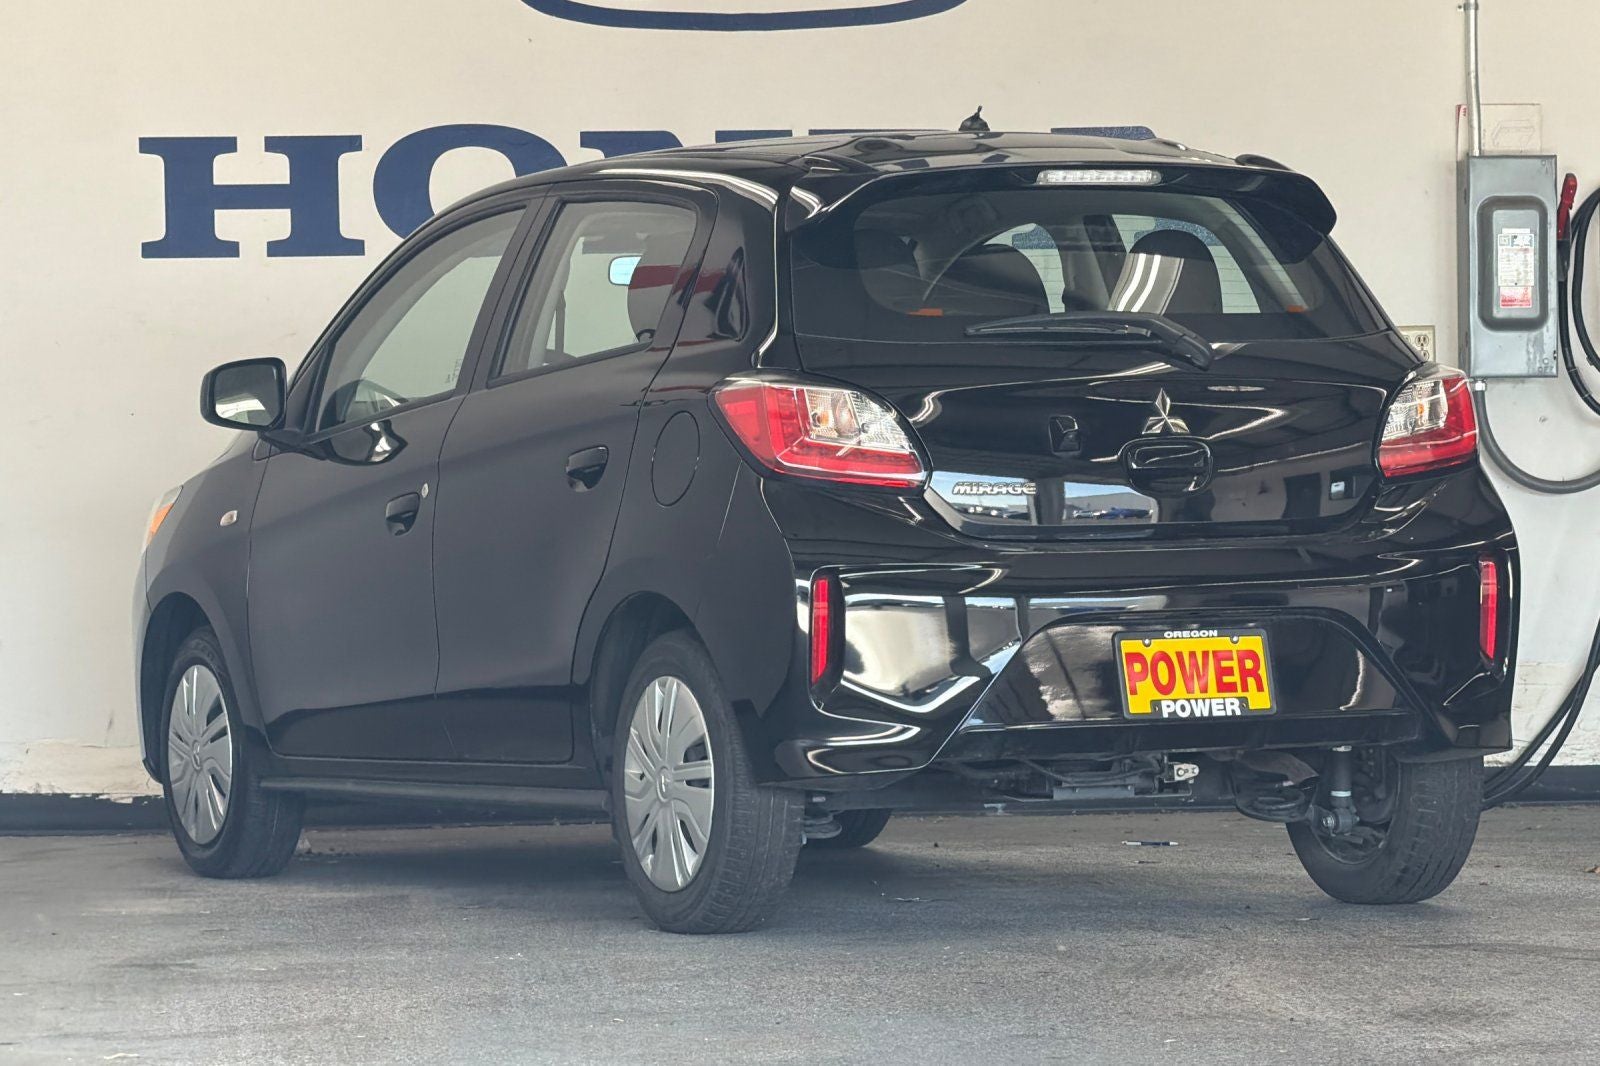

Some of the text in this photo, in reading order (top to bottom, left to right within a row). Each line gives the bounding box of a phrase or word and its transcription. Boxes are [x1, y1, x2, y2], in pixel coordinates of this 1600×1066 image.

[952, 482, 1037, 495] MIRAGE
[1163, 629, 1218, 639] OREGON
[1124, 649, 1265, 696] POWER
[1161, 697, 1241, 718] POWER
